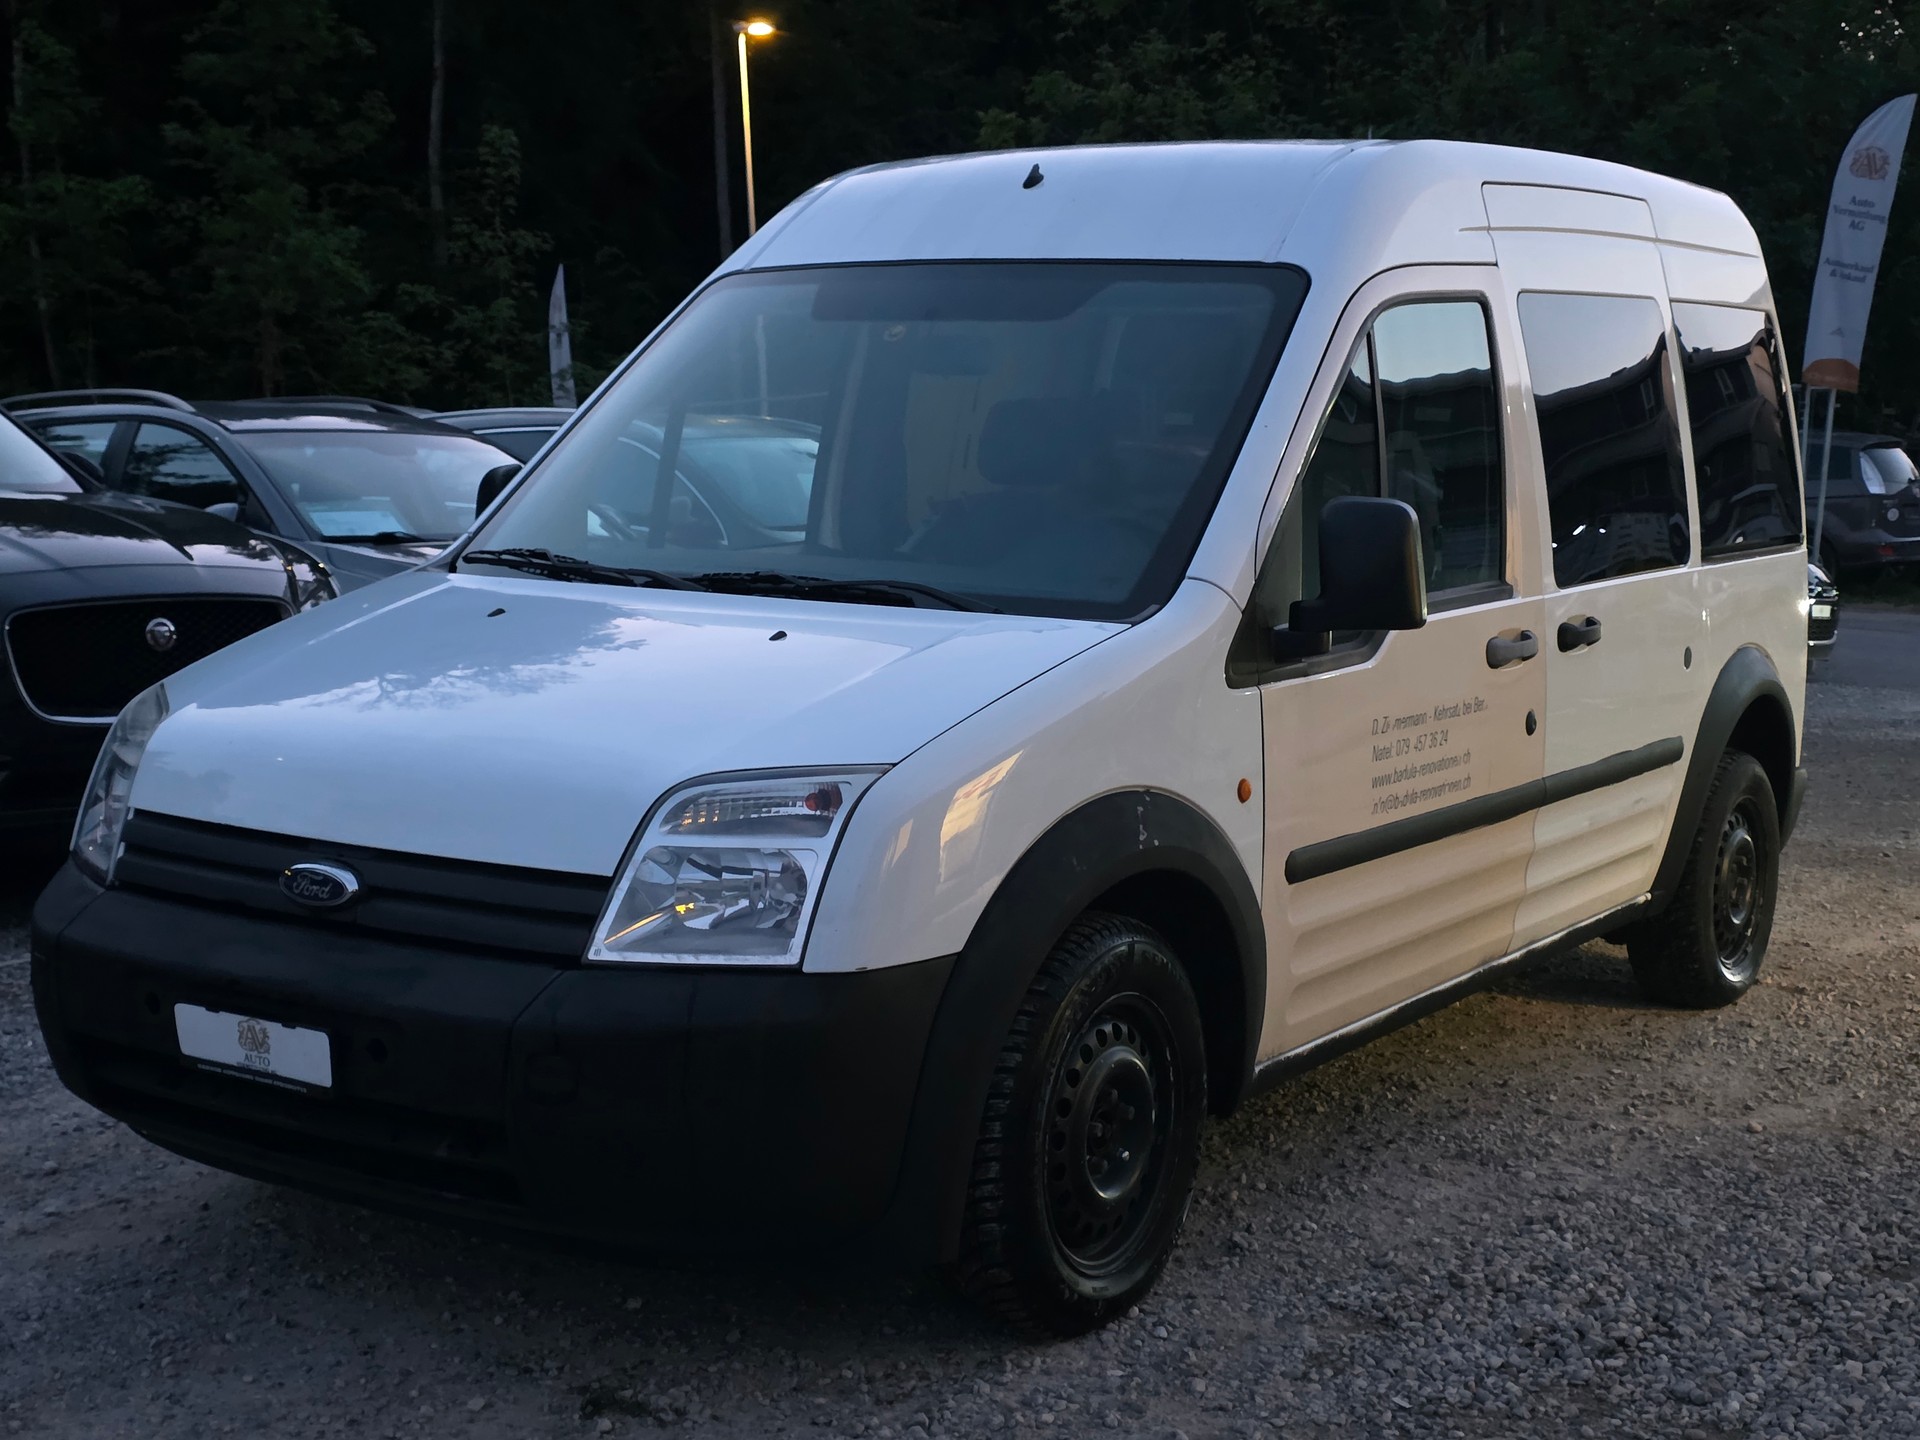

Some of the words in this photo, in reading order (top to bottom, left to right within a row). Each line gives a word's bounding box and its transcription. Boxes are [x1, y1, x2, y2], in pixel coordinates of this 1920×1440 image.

[1849, 195, 1875, 208] Auto
[1848, 219, 1866, 231] AG
[1462, 698, 1472, 715] bei
[1395, 737, 1411, 757] 079
[1413, 734, 1427, 752] 457
[1428, 731, 1438, 749] 36
[1439, 729, 1449, 746] 24
[293, 872, 333, 898] Ford
[244, 1053, 271, 1067] AUTO
